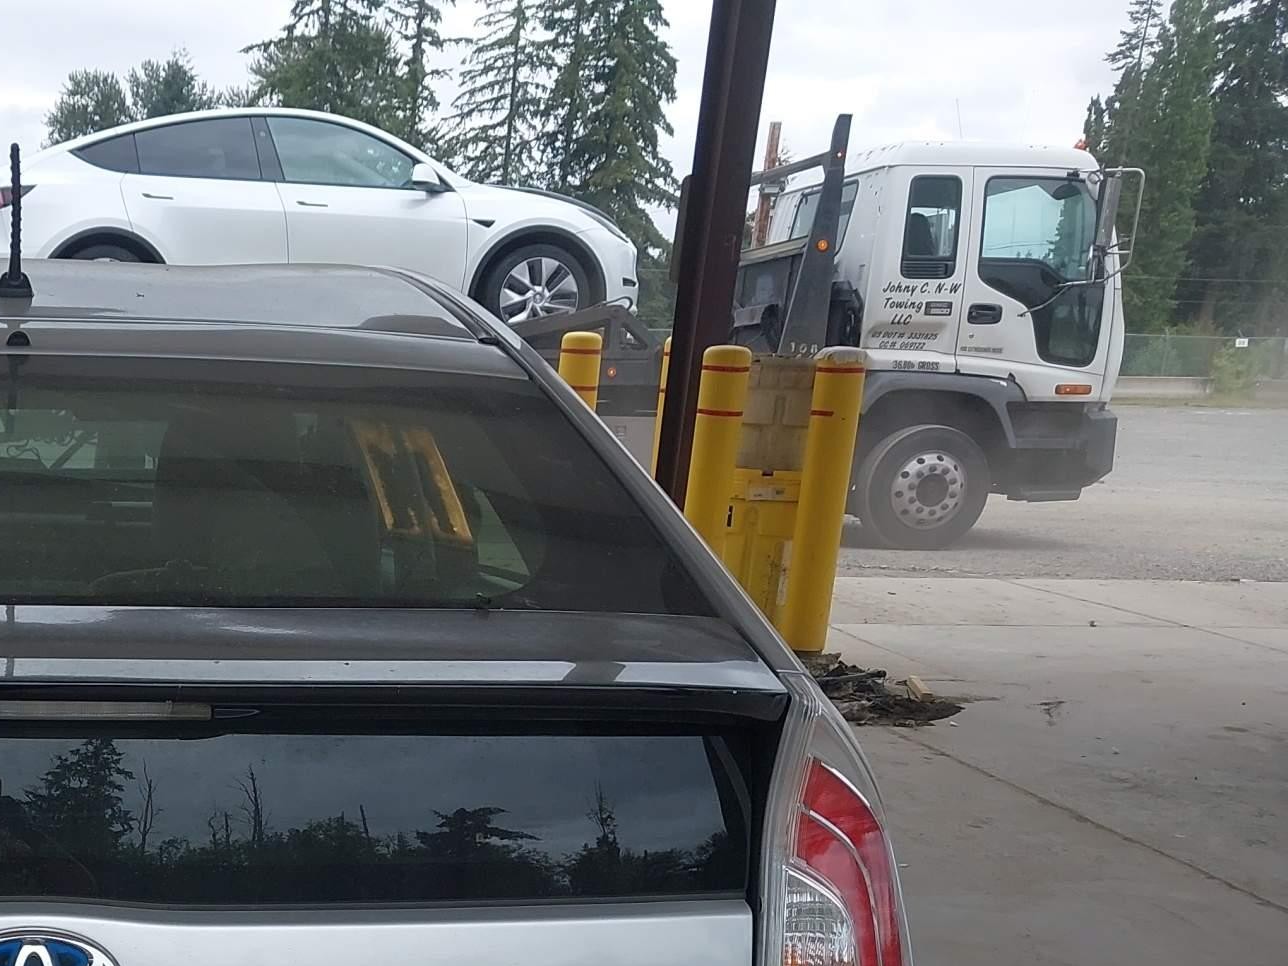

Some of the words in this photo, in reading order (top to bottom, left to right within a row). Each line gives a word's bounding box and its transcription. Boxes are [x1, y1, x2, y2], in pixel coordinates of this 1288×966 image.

[882, 281, 918, 296] Johny
[920, 282, 930, 294] C.
[934, 282, 962, 294] N-W
[883, 297, 923, 313] Towing
[890, 314, 912, 325] LLC
